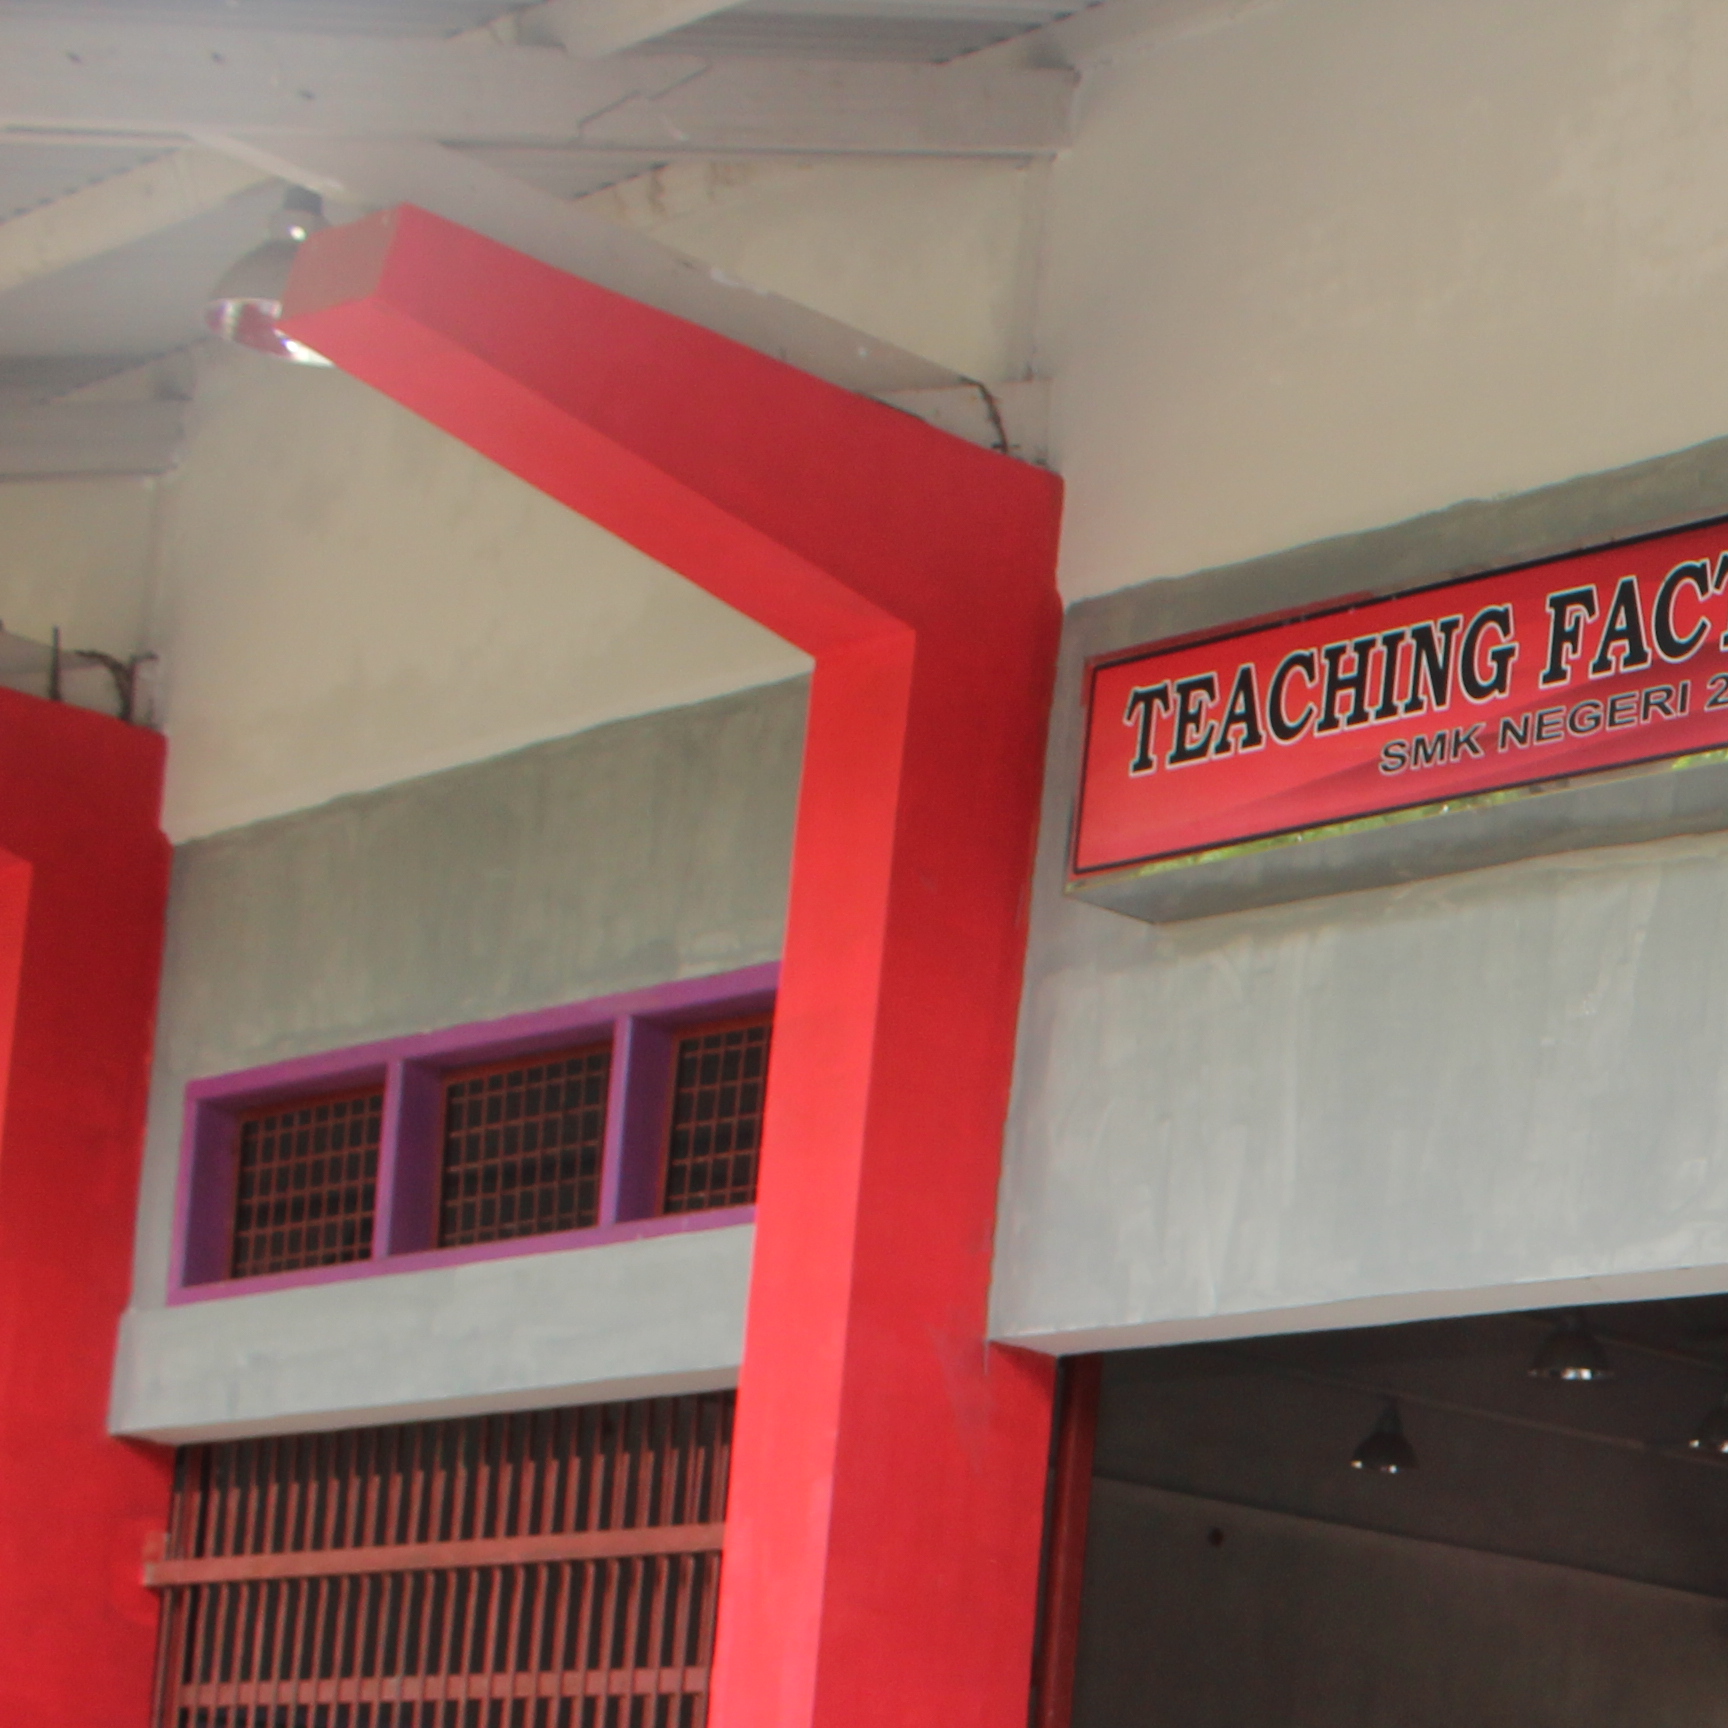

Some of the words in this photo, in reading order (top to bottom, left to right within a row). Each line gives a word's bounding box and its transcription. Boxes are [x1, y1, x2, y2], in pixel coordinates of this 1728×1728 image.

[1123, 606, 1517, 778] TEACHING
[1379, 722, 1482, 775] SMK
[1497, 682, 1692, 751] NEGERI
